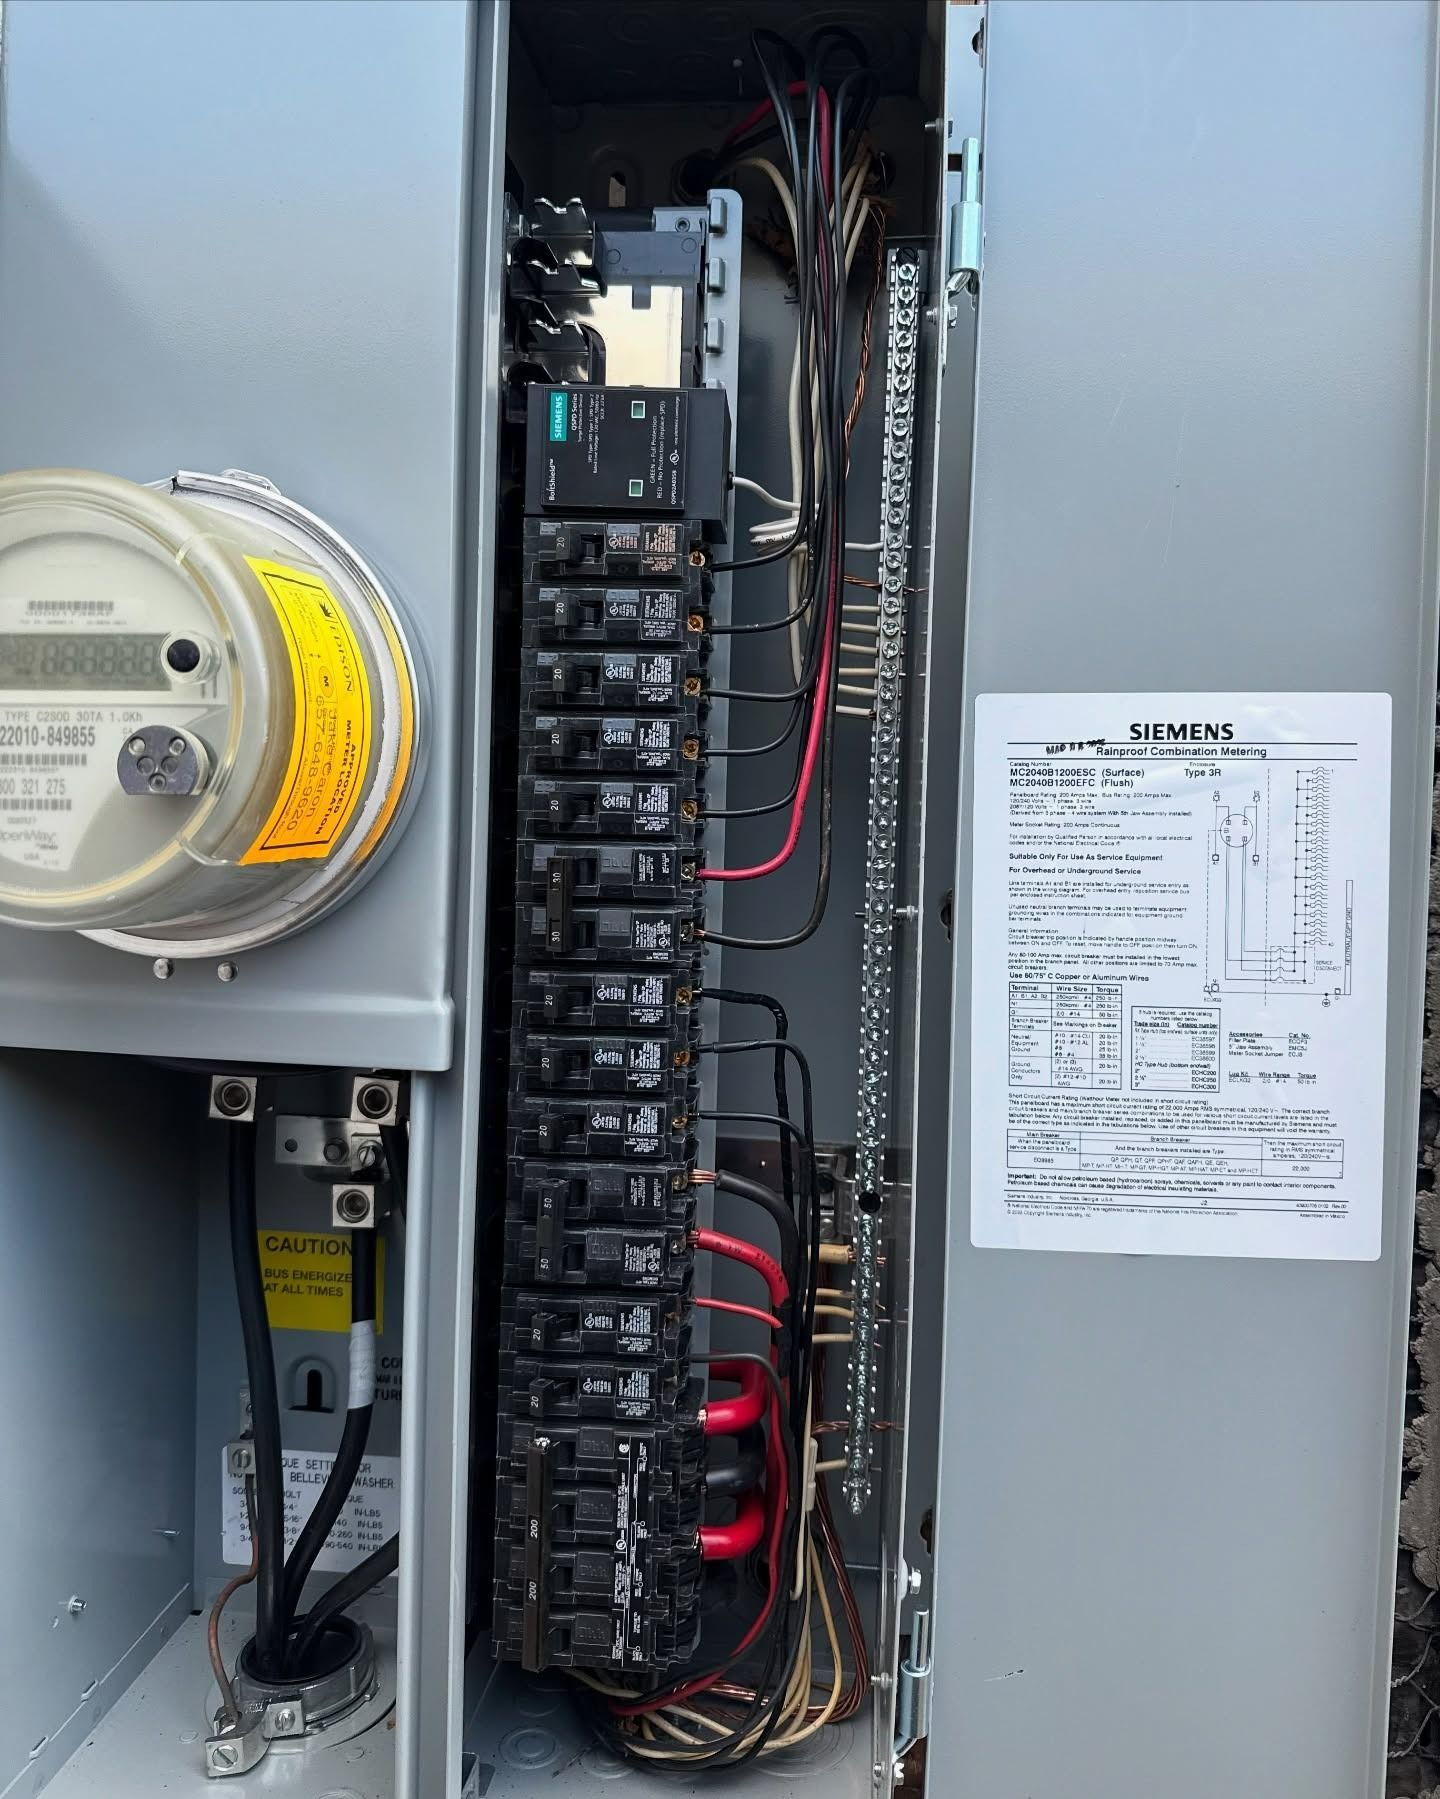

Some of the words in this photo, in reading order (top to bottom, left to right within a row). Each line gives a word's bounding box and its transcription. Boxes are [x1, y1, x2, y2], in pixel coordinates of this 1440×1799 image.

[555, 396, 563, 438] SIEMENS
[657, 472, 663, 480] No
[557, 537, 564, 547] 20
[556, 603, 564, 613] 20
[554, 669, 561, 679] 20
[6, 712, 29, 722] TYPE
[1129, 723, 1234, 741] SIEMENS
[341, 720, 352, 766] METER
[552, 734, 559, 744] 20
[1096, 746, 1148, 758] Rainproof
[1151, 746, 1218, 758] Combination
[1221, 746, 1267, 758] Metering
[333, 744, 356, 814] APPROVED
[1010, 769, 1095, 777] MC2040B1200ESC
[1101, 769, 1144, 778] (Surface)
[1184, 769, 1204, 778] Type
[1206, 769, 1222, 777] 3R
[22, 779, 39, 794] 321
[46, 779, 65, 794] 275
[1010, 779, 1095, 787] MC2040B1200EFC
[1101, 779, 1133, 788] (Flush)
[306, 762, 332, 818] Caron
[315, 771, 346, 835] LOCATION
[551, 800, 559, 810] 20
[553, 872, 561, 883] 30
[552, 931, 560, 942] 30
[545, 995, 553, 1005] 20
[542, 1057, 549, 1068] 20
[540, 1126, 548, 1136] 20
[544, 1198, 552, 1208] 50
[265, 1236, 352, 1256] CAUTION
[540, 1258, 549, 1271] 50
[264, 1269, 289, 1278] BUS
[293, 1270, 352, 1283] ENERGIZE
[264, 1284, 277, 1292] AT
[282, 1285, 303, 1294] ALL
[307, 1287, 344, 1297] TIMES
[533, 1329, 541, 1340] 20
[531, 1396, 539, 1408] 20
[290, 1472, 328, 1484] BELLEV
[355, 1478, 394, 1488] WASHER
[530, 1519, 538, 1538] 200
[529, 1582, 537, 1600] 200
